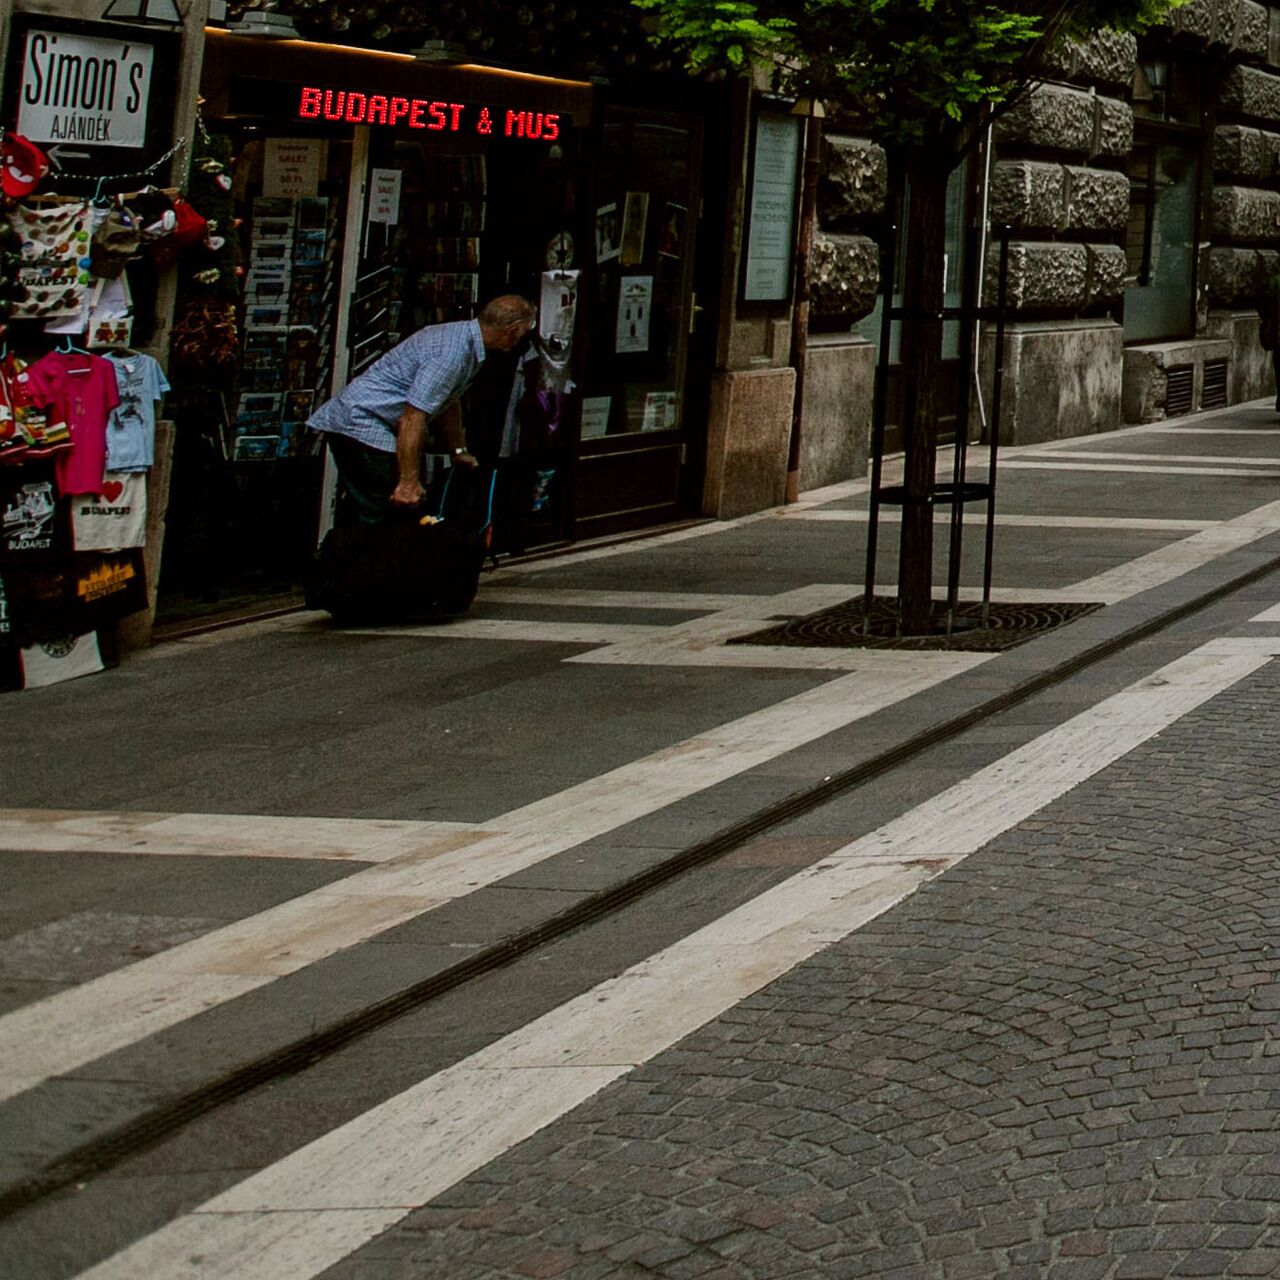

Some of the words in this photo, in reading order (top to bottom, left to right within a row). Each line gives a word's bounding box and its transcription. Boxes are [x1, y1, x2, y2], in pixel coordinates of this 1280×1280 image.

[25, 33, 143, 114] Simon's
[50, 112, 111, 141] AJÁNDÉK
[298, 86, 465, 131] BUDAPEST
[475, 106, 493, 135] &
[503, 109, 560, 141] MUS
